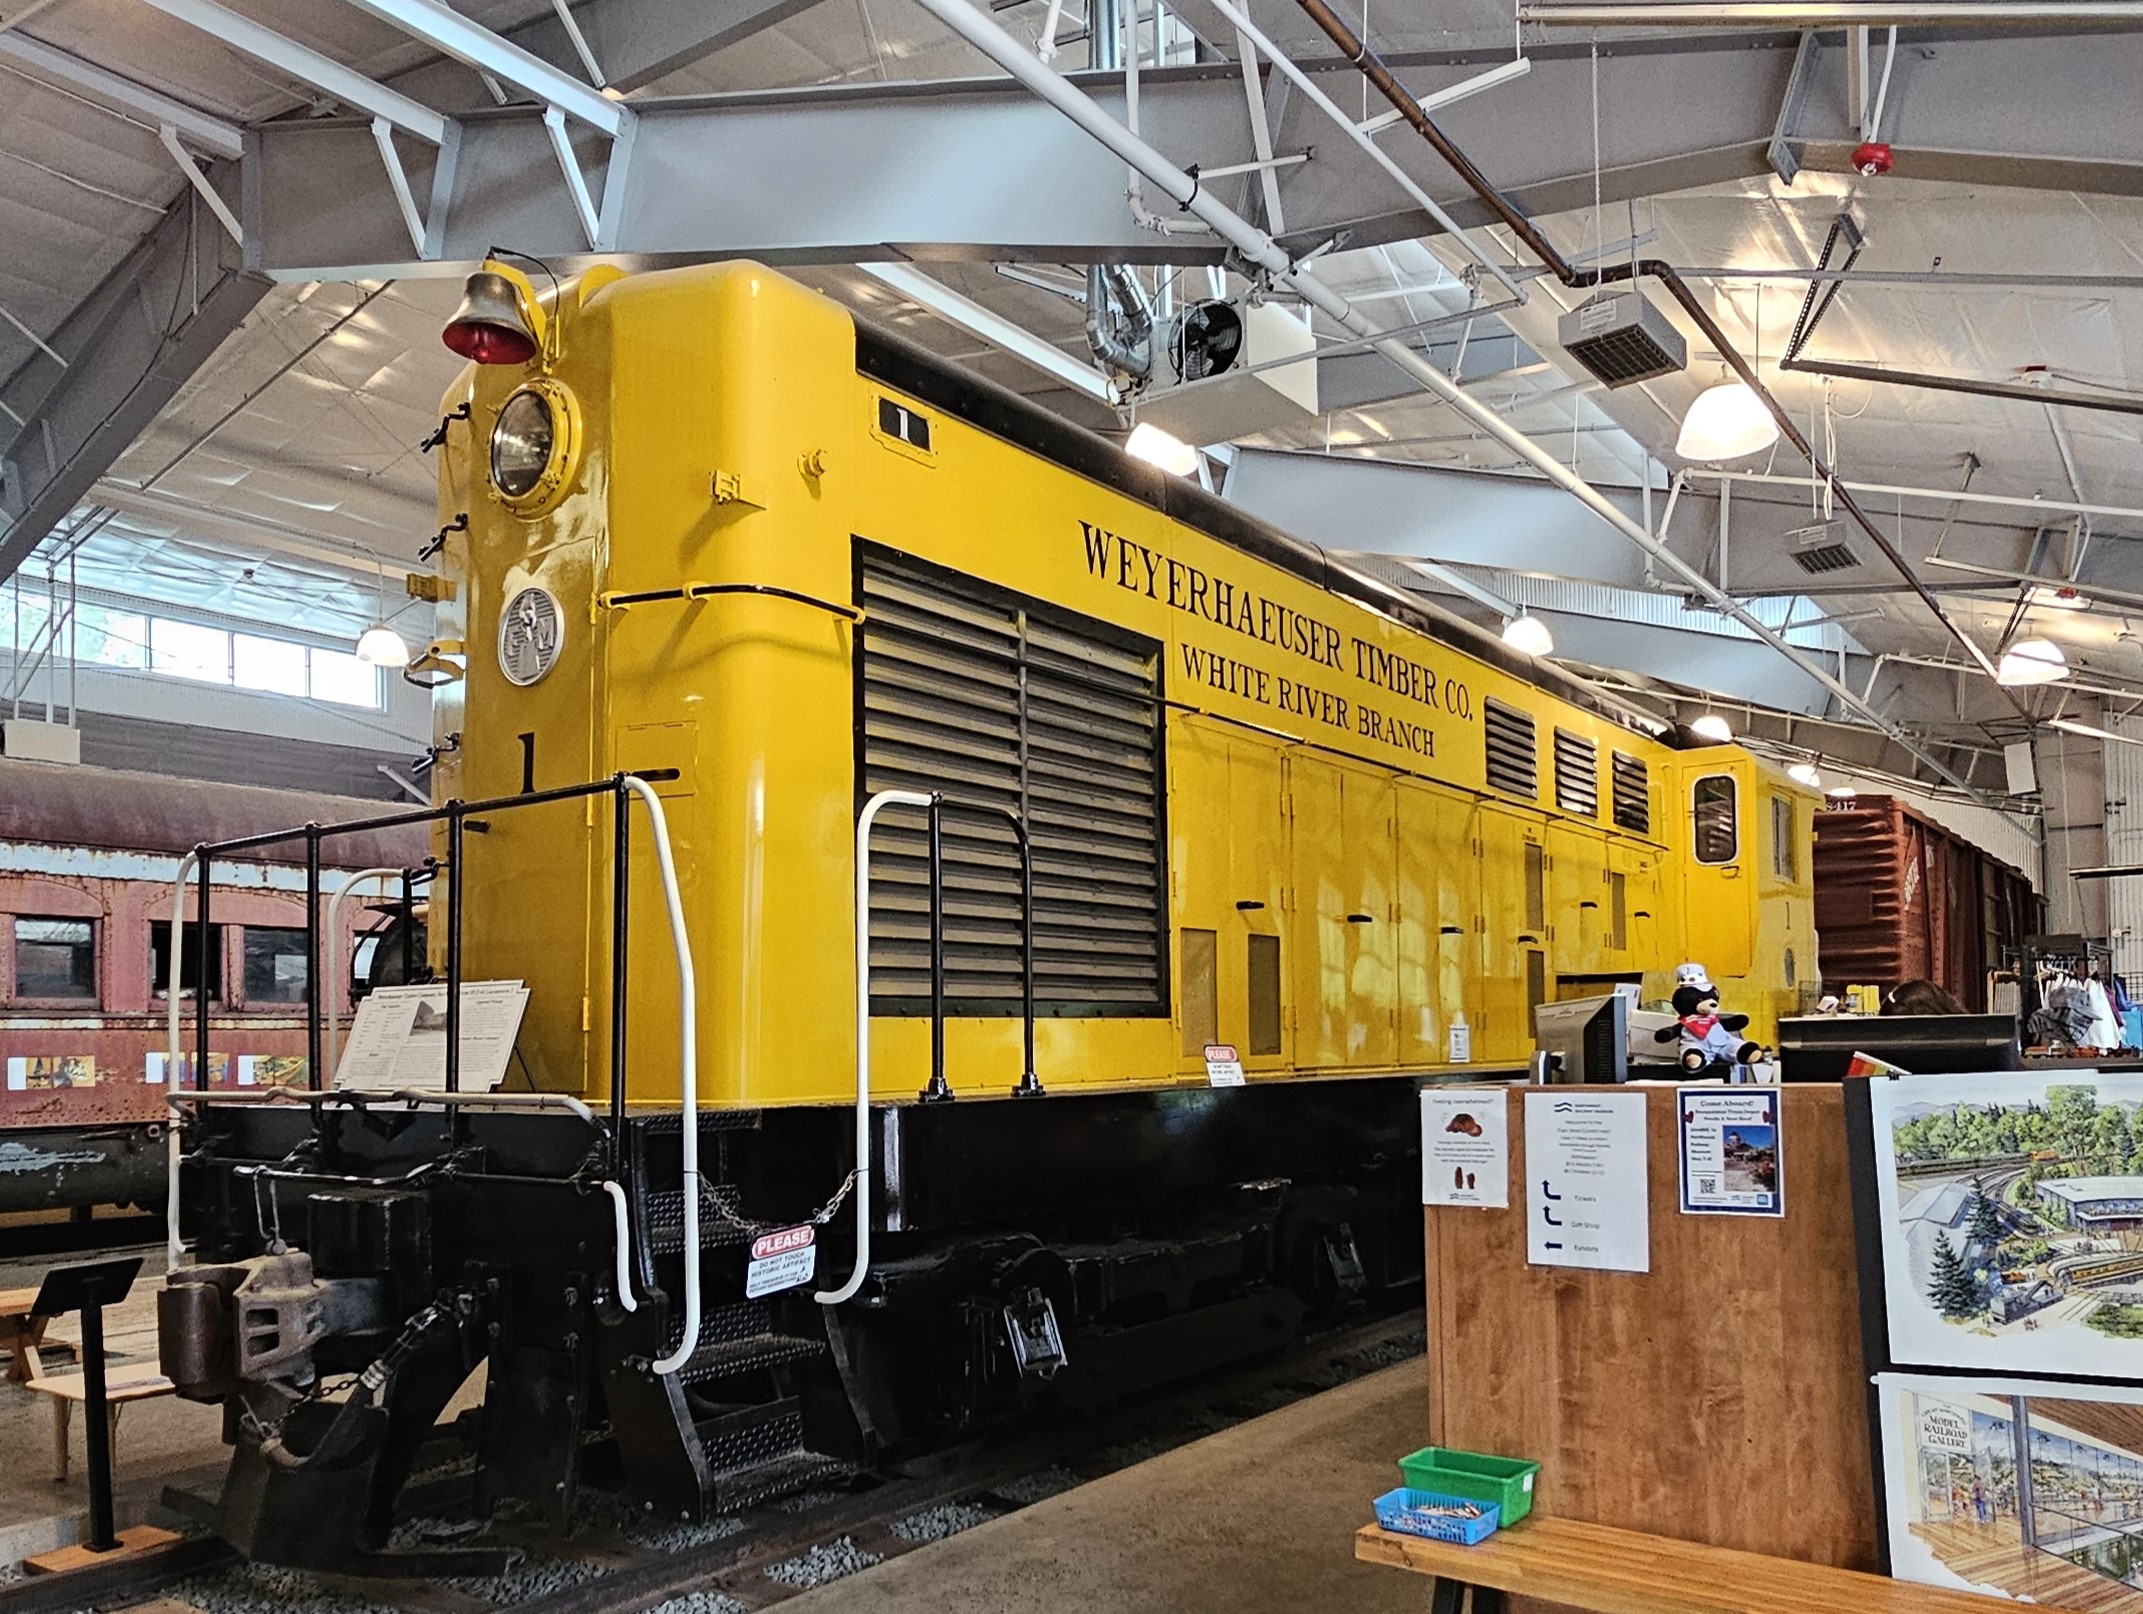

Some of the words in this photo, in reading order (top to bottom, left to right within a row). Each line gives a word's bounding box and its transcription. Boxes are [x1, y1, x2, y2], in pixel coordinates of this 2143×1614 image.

[896, 407, 911, 444] 1
[1078, 519, 1344, 672] WEYERHAEUSER
[1351, 637, 1439, 709] TIMBER
[1444, 678, 1474, 722] CO.
[1180, 643, 1271, 705] WHITE
[1277, 677, 1351, 731] RIVER
[1358, 706, 1435, 758] BRANCH
[517, 732, 536, 794] 1
[757, 1230, 809, 1256] PLEASE
[751, 1266, 780, 1278] HISTORIC
[782, 1256, 812, 1269] ARTIFACT
[770, 1257, 783, 1266] NOT
[785, 1251, 805, 1262] TOUCH
[1924, 1423, 1967, 1439] RAILROAD
[1929, 1415, 1959, 1430] MODEL
[1928, 1434, 1966, 1448] GALLERY
